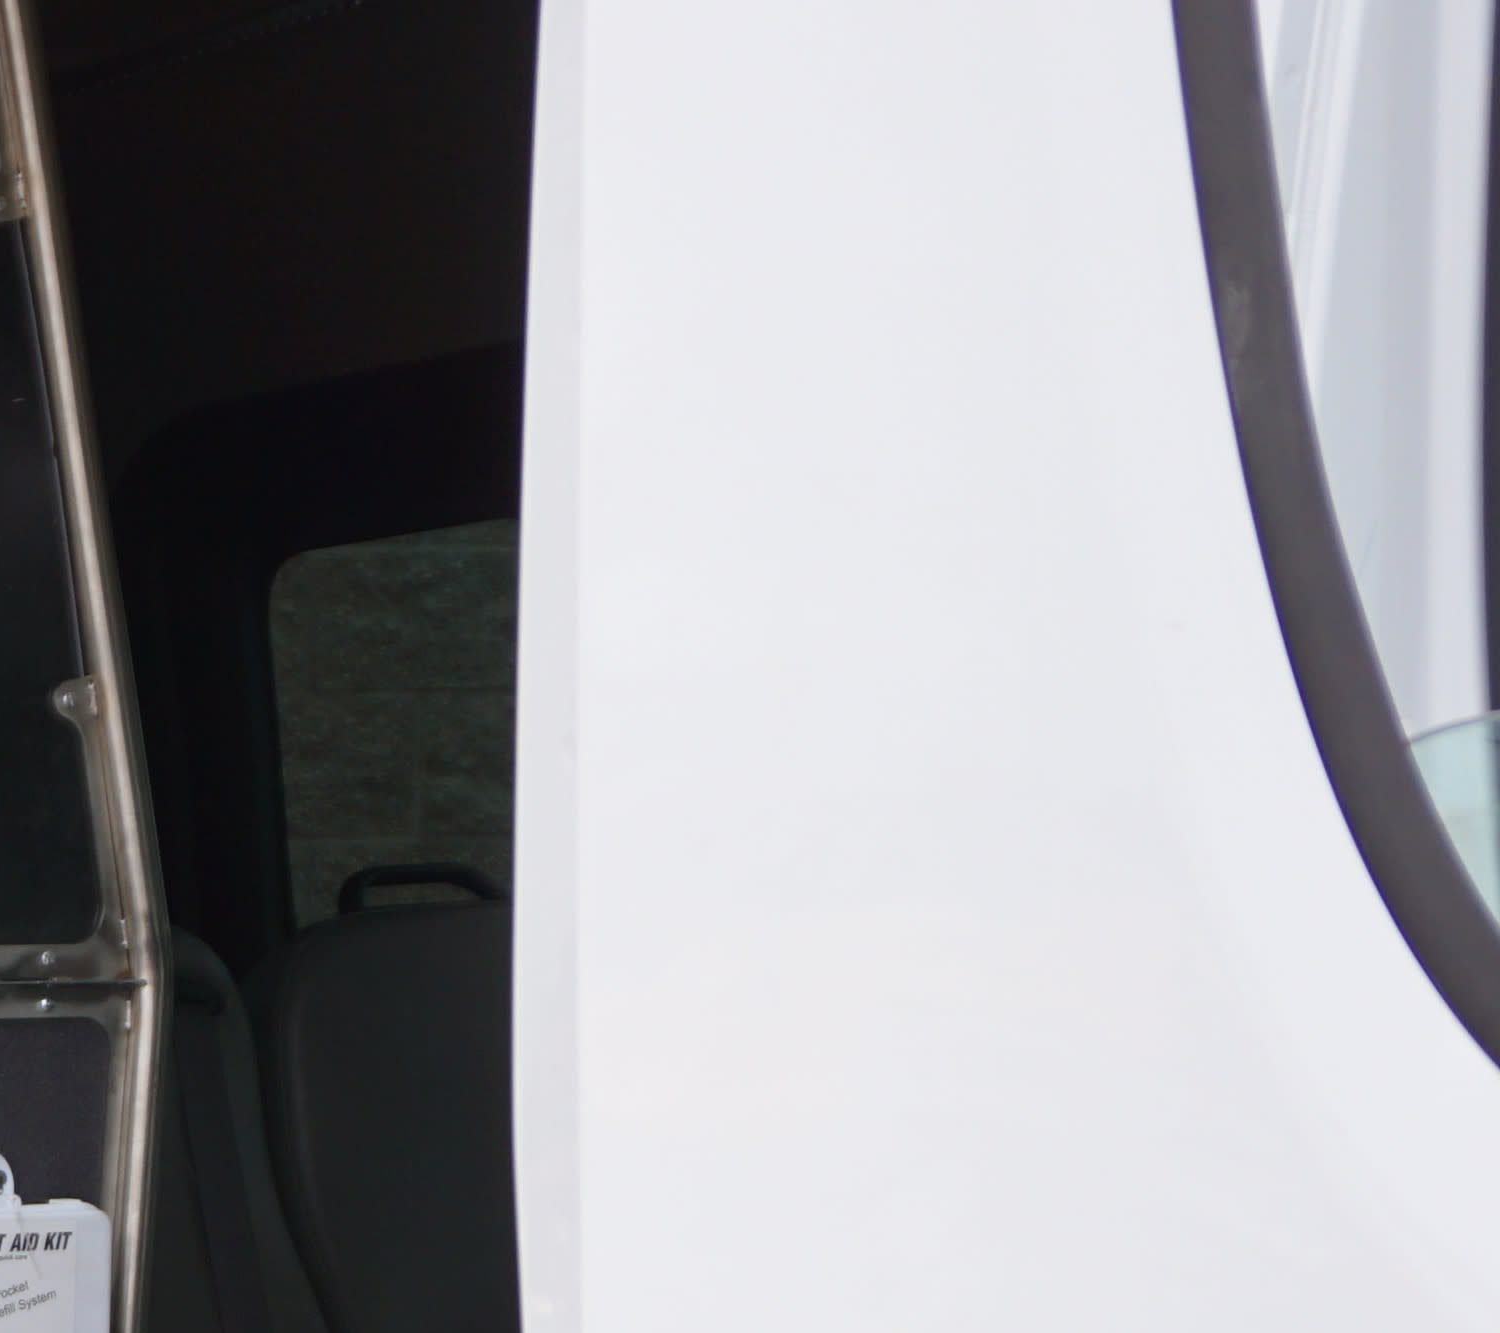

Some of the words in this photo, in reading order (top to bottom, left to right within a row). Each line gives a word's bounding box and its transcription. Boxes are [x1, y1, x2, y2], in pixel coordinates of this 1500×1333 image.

[10, 1232, 40, 1253] AID
[43, 1231, 73, 1252] KIT
[18, 1289, 57, 1312] System
